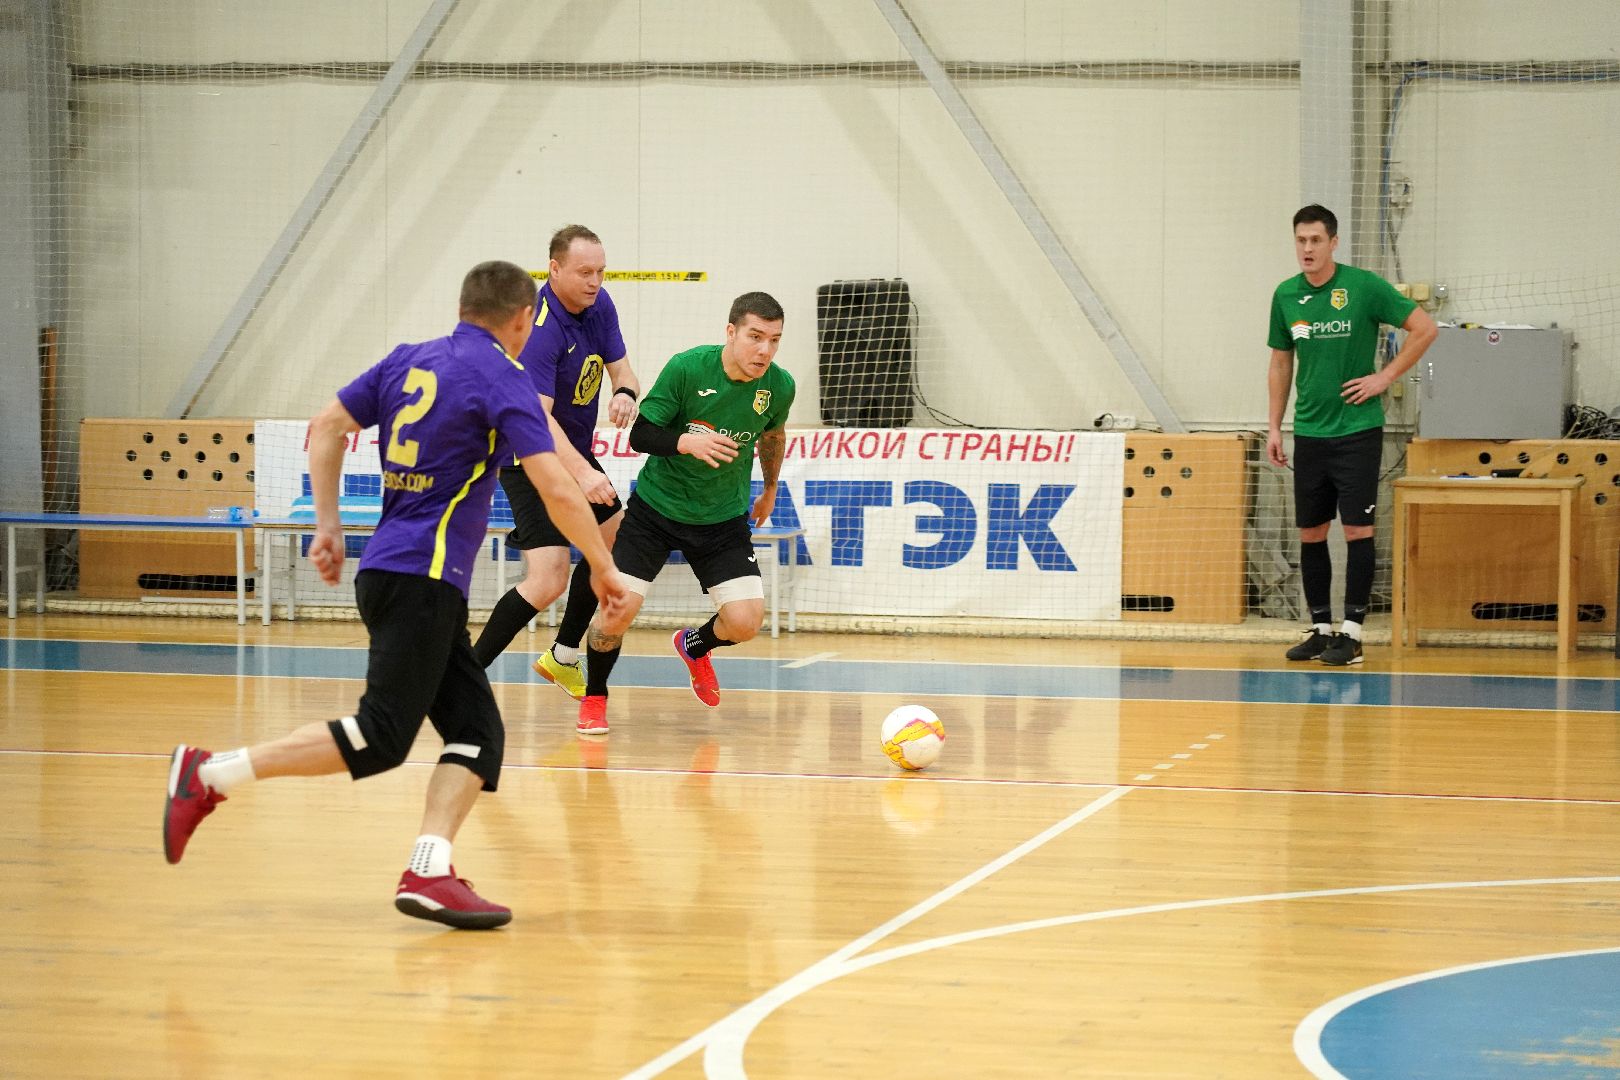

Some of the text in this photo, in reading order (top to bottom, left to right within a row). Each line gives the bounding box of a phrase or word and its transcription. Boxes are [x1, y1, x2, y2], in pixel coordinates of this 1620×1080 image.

[1312, 320, 1351, 333] РИОН
[386, 367, 438, 468] 2
[719, 428, 756, 442] РИО
[918, 432, 1075, 463] СТРАНЫ!
[748, 480, 1078, 572] АТЭК
